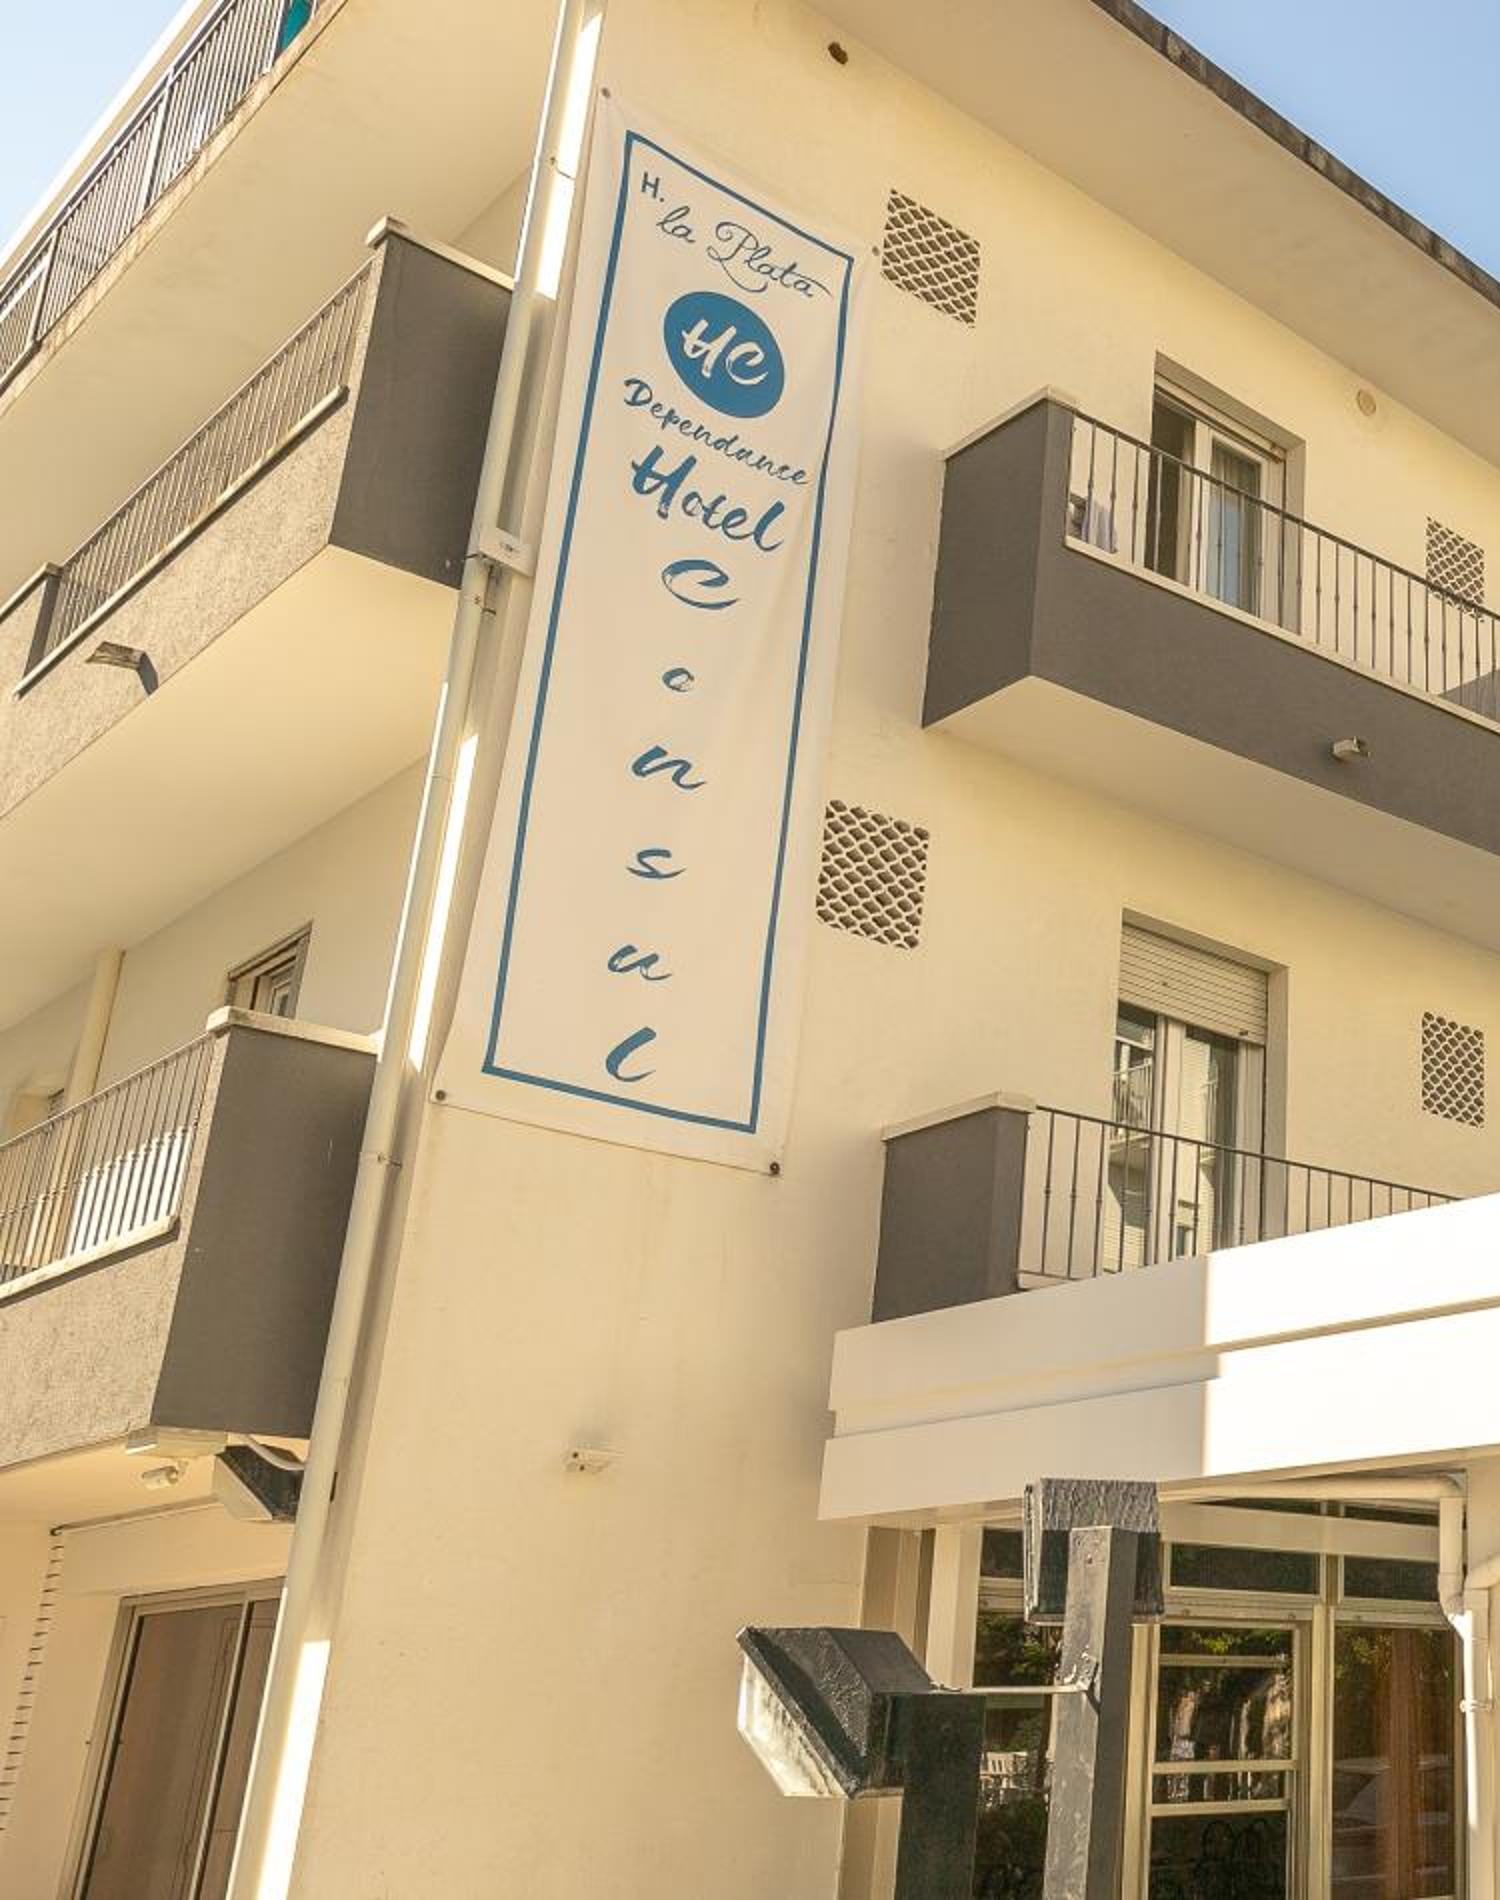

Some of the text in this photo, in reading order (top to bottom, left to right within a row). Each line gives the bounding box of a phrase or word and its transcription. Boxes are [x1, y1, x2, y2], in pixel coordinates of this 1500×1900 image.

[640, 172, 665, 203] H.
[656, 205, 832, 298] la Plata
[682, 319, 769, 386] HC
[624, 377, 810, 486] Dependance
[631, 444, 786, 553] Hotel
